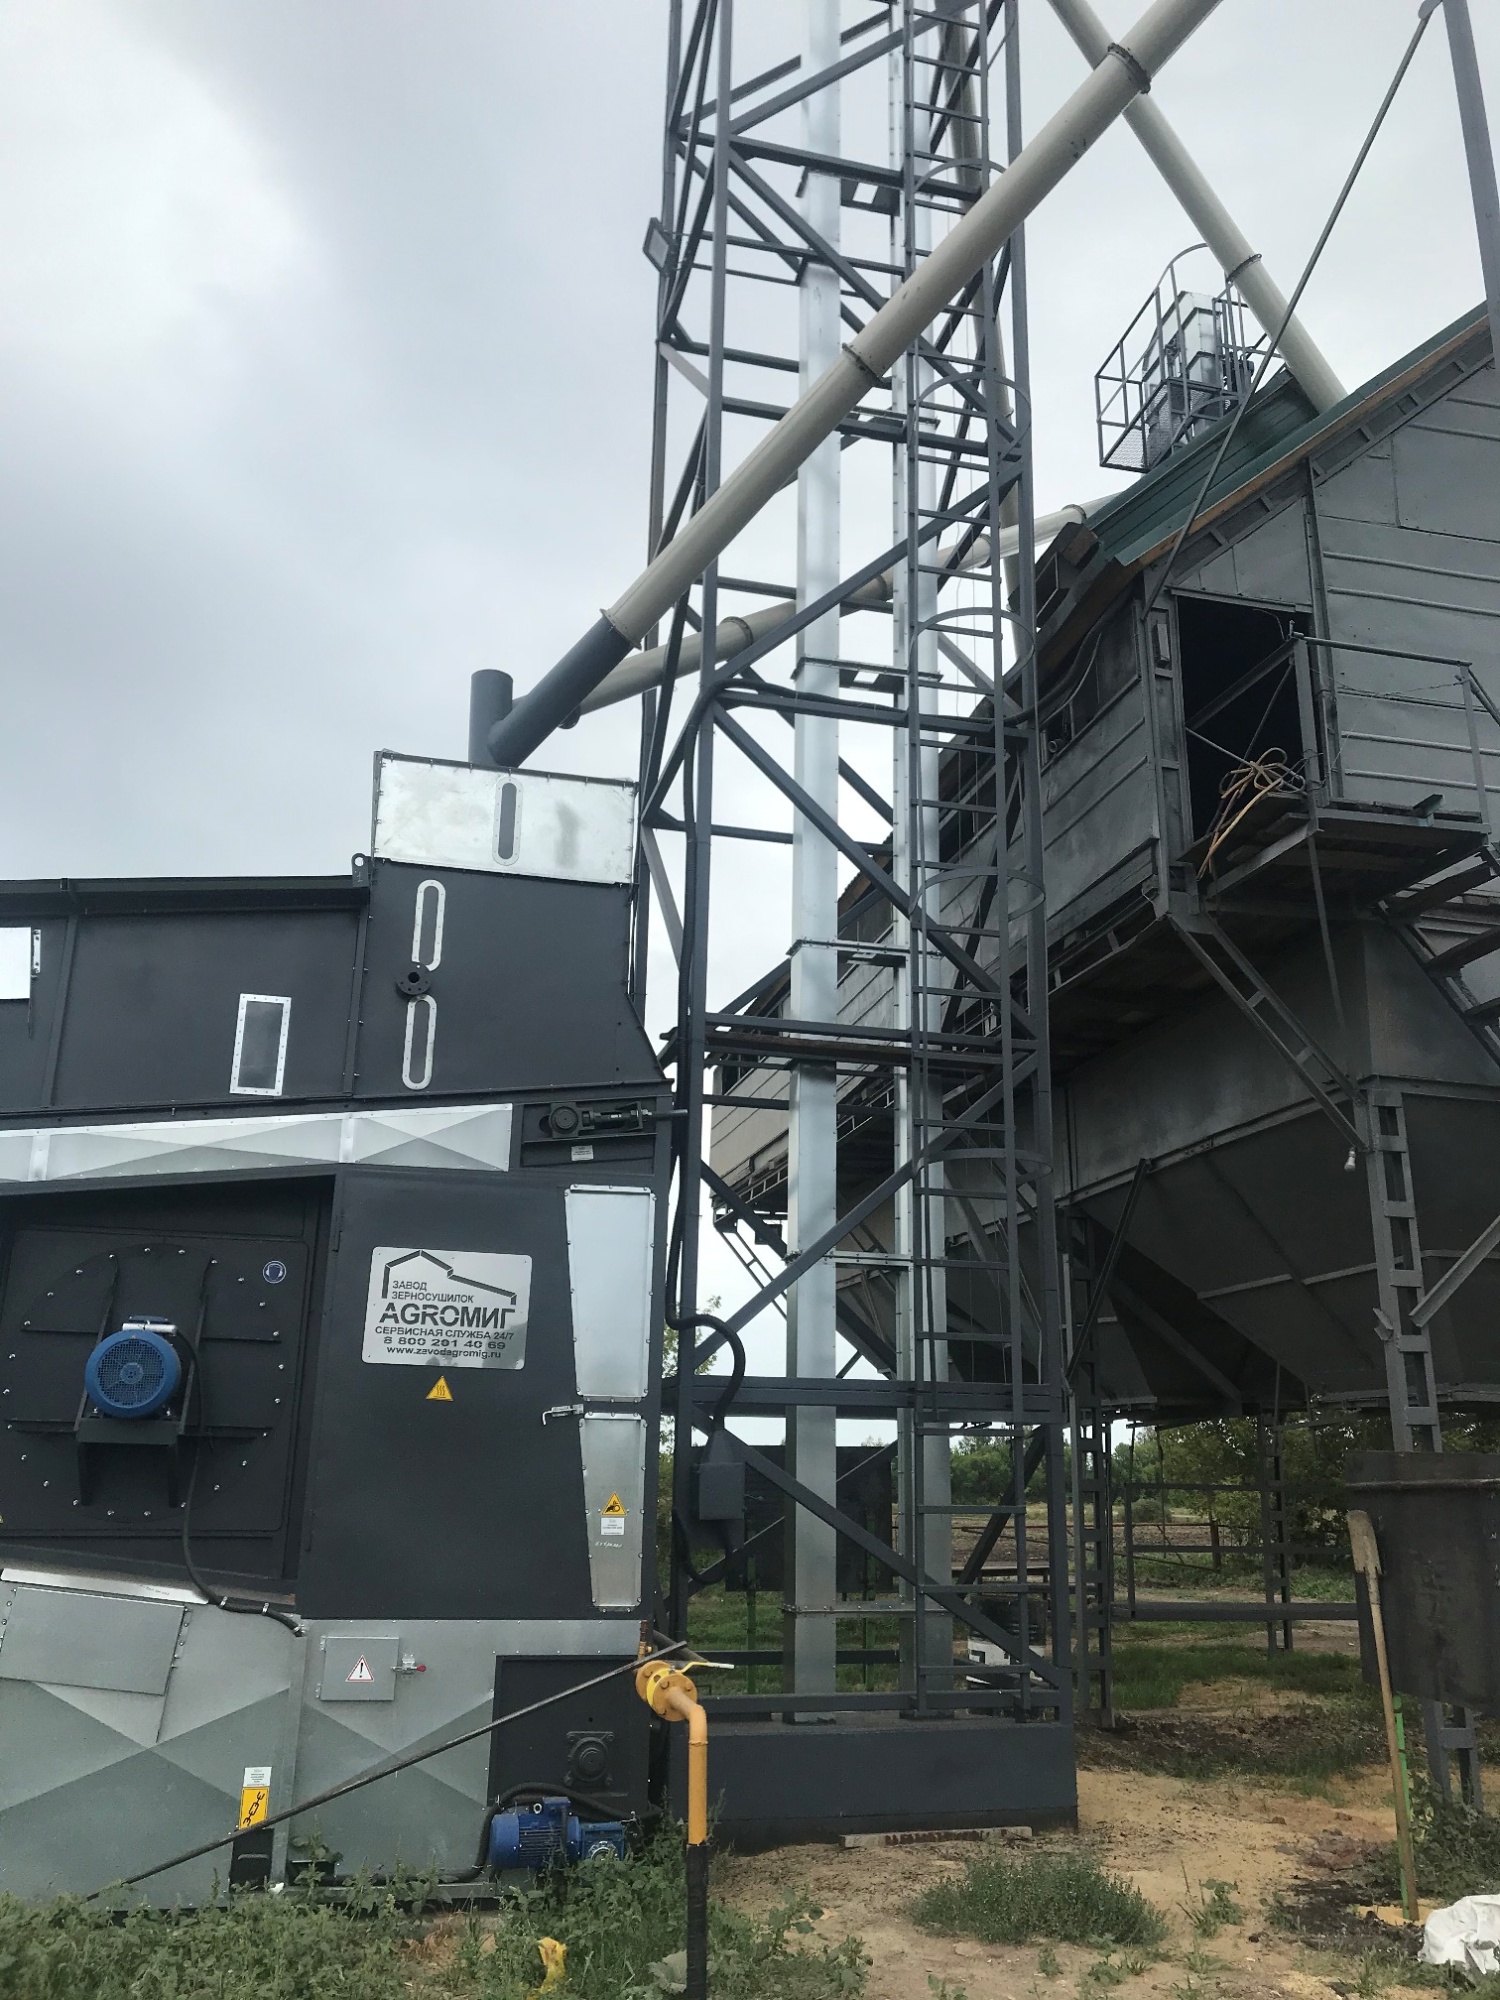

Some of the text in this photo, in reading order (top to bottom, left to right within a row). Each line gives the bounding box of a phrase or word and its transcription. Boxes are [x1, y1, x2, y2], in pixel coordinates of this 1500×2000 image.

[392, 1280, 428, 1291] ЗАВОД
[391, 1291, 474, 1303] ЗЕРНОСУШИЛОК
[375, 1326, 514, 1341] СЕРВИСНАЯ СЛУЖБА 24/7
[383, 1336, 393, 1344] 8
[397, 1337, 427, 1346] 800
[386, 1346, 502, 1359] www.zavodagromig.ru
